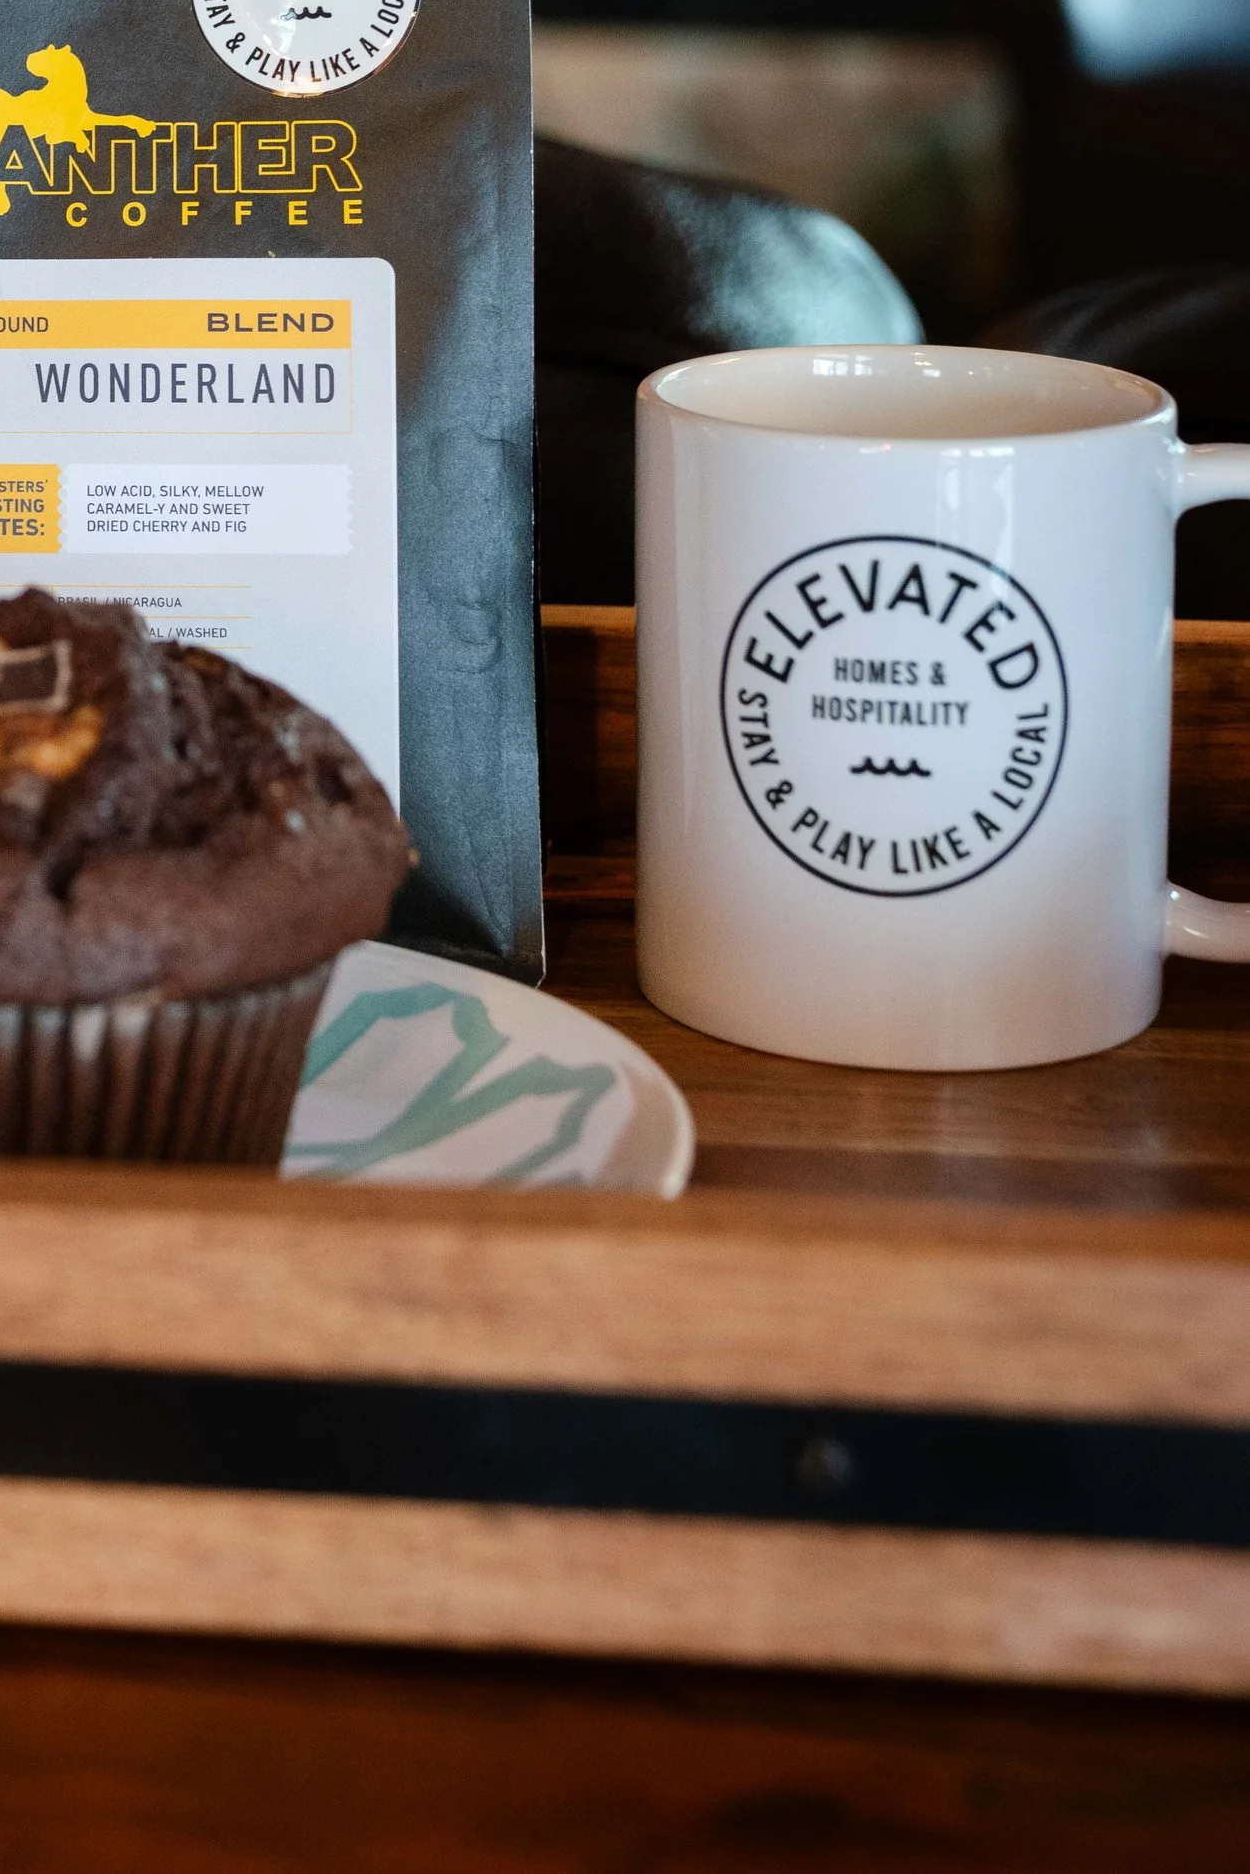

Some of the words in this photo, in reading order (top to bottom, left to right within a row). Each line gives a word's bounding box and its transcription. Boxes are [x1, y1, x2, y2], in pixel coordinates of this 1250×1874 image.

[225, 32, 245, 53] &
[245, 46, 300, 82] PLAY
[310, 48, 360, 83] LIKE
[359, 37, 379, 57] A
[66, 200, 363, 227] COFFEE
[207, 312, 335, 333] BLEND
[36, 363, 336, 403] WONDERLAND
[87, 485, 116, 497] LOW
[121, 485, 155, 498] ACID,
[160, 485, 201, 498] SILKY,
[205, 485, 264, 497] MELLOW
[87, 503, 165, 515] CARAMEL-Y
[170, 503, 198, 515] AND
[203, 503, 250, 515] SWEET
[87, 520, 128, 532] DRIED
[133, 520, 187, 532] CHERRY
[192, 520, 220, 533] AND
[225, 520, 247, 533] FIG
[176, 628, 227, 638] WASHED
[744, 559, 1039, 690] ELEVATED
[834, 658, 919, 686] HOMES
[930, 661, 947, 686] &
[812, 695, 970, 726] HOSPITALITY
[737, 688, 779, 766] STAY
[765, 780, 793, 810] &
[791, 808, 876, 870] PLAY
[890, 827, 970, 874] LIKE
[971, 810, 1001, 840] A
[991, 702, 1049, 811] LOCAL
